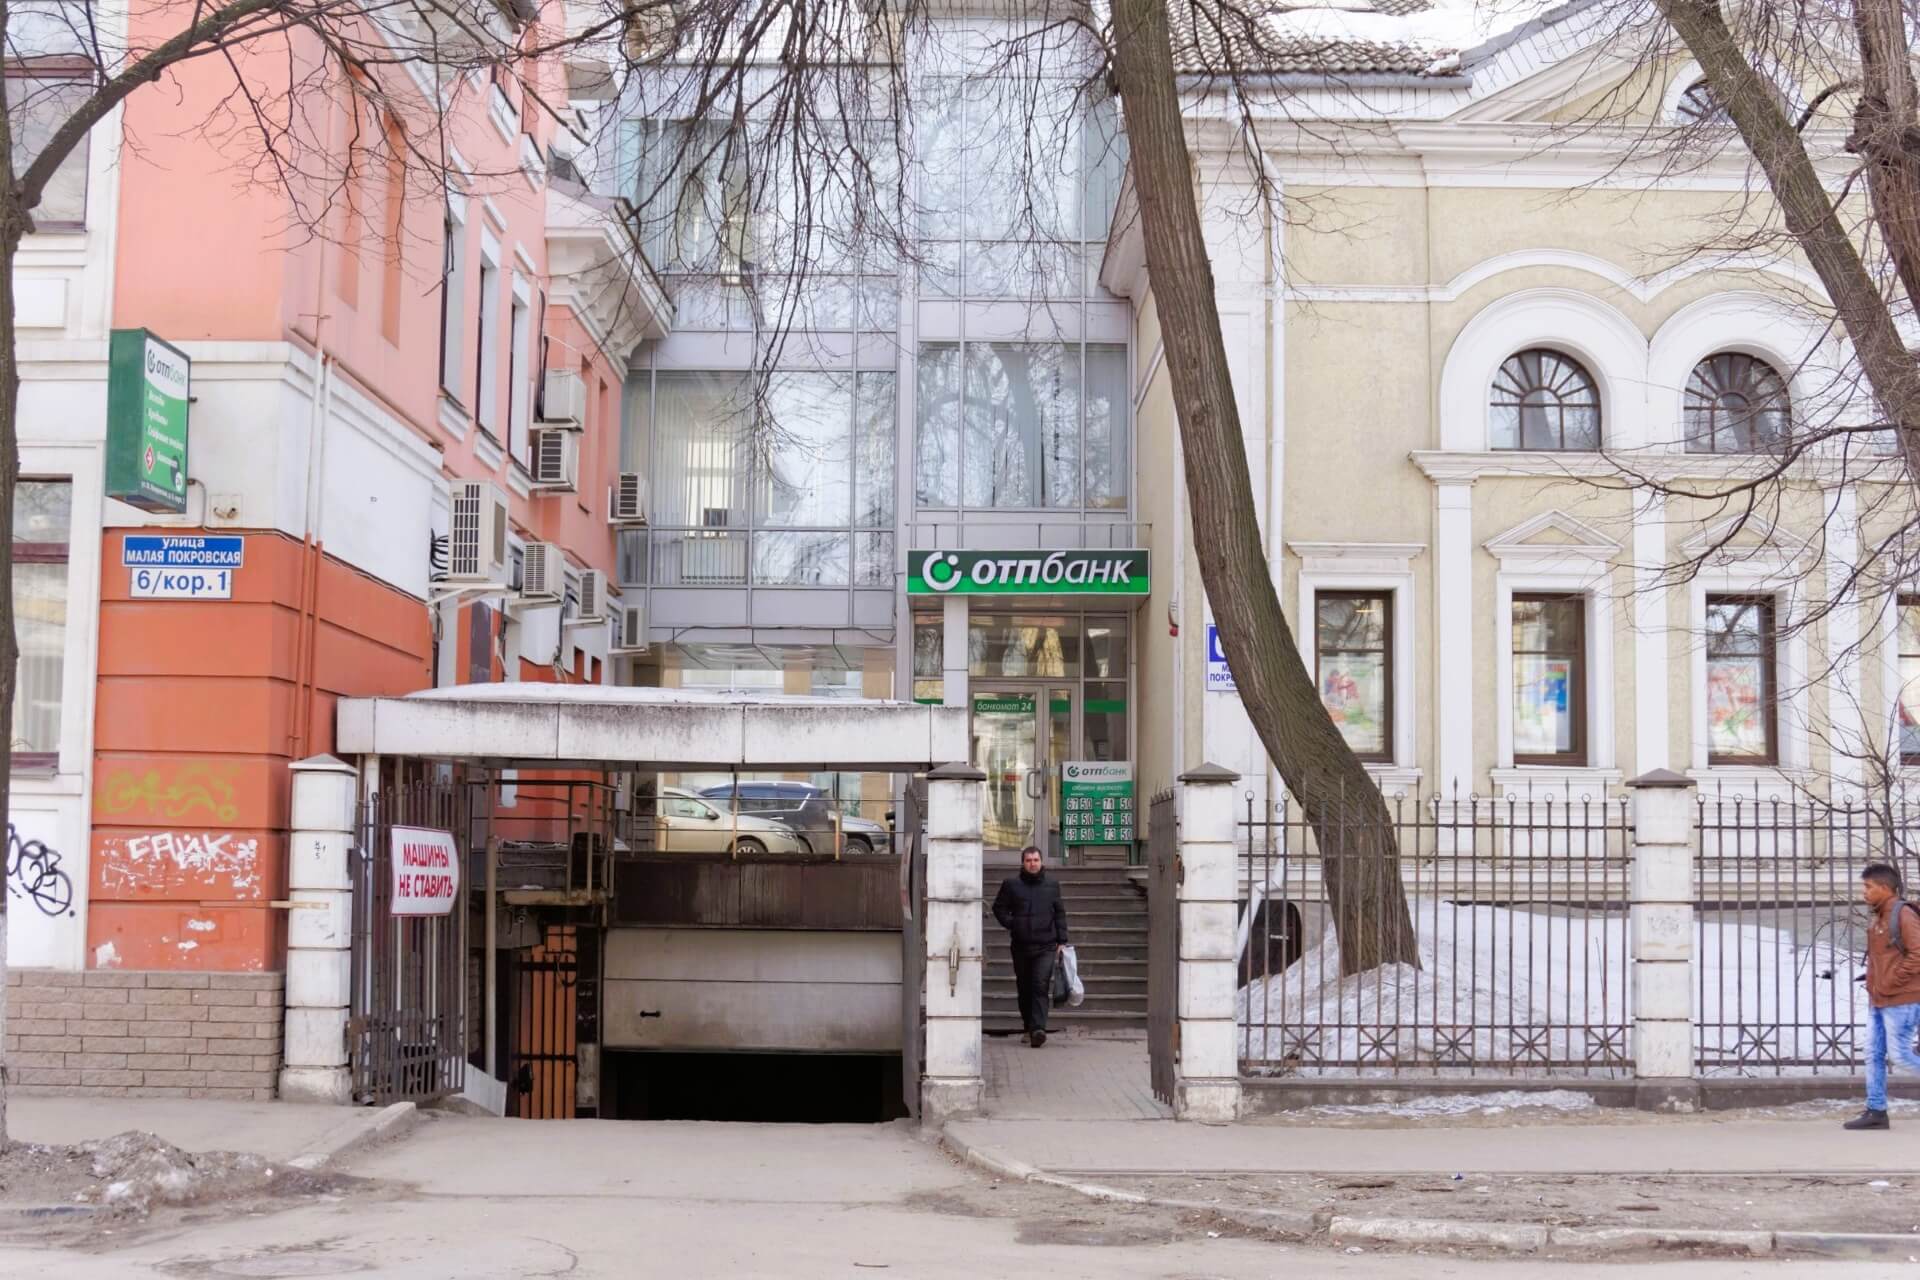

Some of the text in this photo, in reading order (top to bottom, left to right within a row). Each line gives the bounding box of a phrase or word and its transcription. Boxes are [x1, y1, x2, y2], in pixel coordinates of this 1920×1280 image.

[162, 538, 206, 550] улица
[126, 549, 241, 564] МАЛАЯ ПОКРОВСКАЯ
[1021, 702, 1032, 712] 24
[403, 843, 449, 867] МАШИНЫ
[399, 874, 453, 898] НЕ СТАВИТЬ
